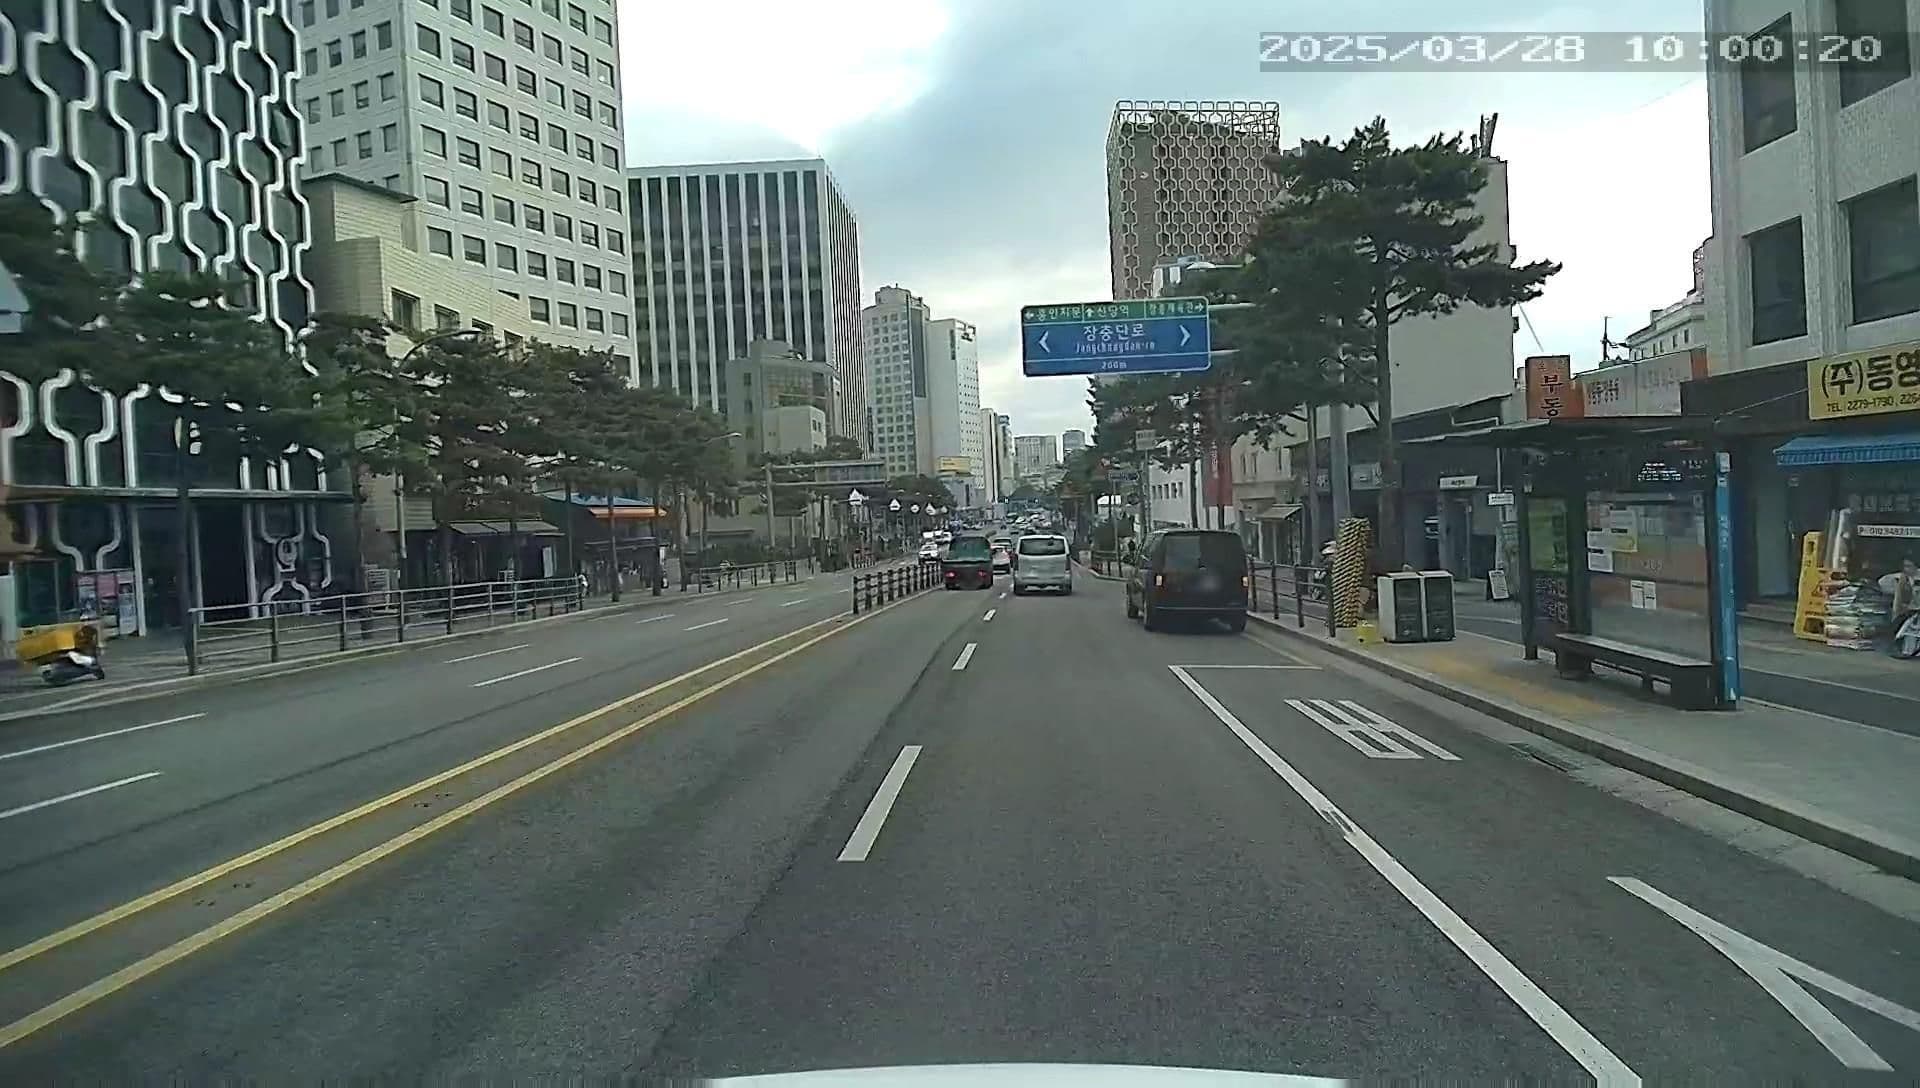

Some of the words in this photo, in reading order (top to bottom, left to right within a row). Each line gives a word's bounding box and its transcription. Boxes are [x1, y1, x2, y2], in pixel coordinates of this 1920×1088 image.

[1097, 304, 1129, 317] 신당역
[1083, 323, 1145, 342] 장충단로
[1826, 402, 1842, 412] TEL
